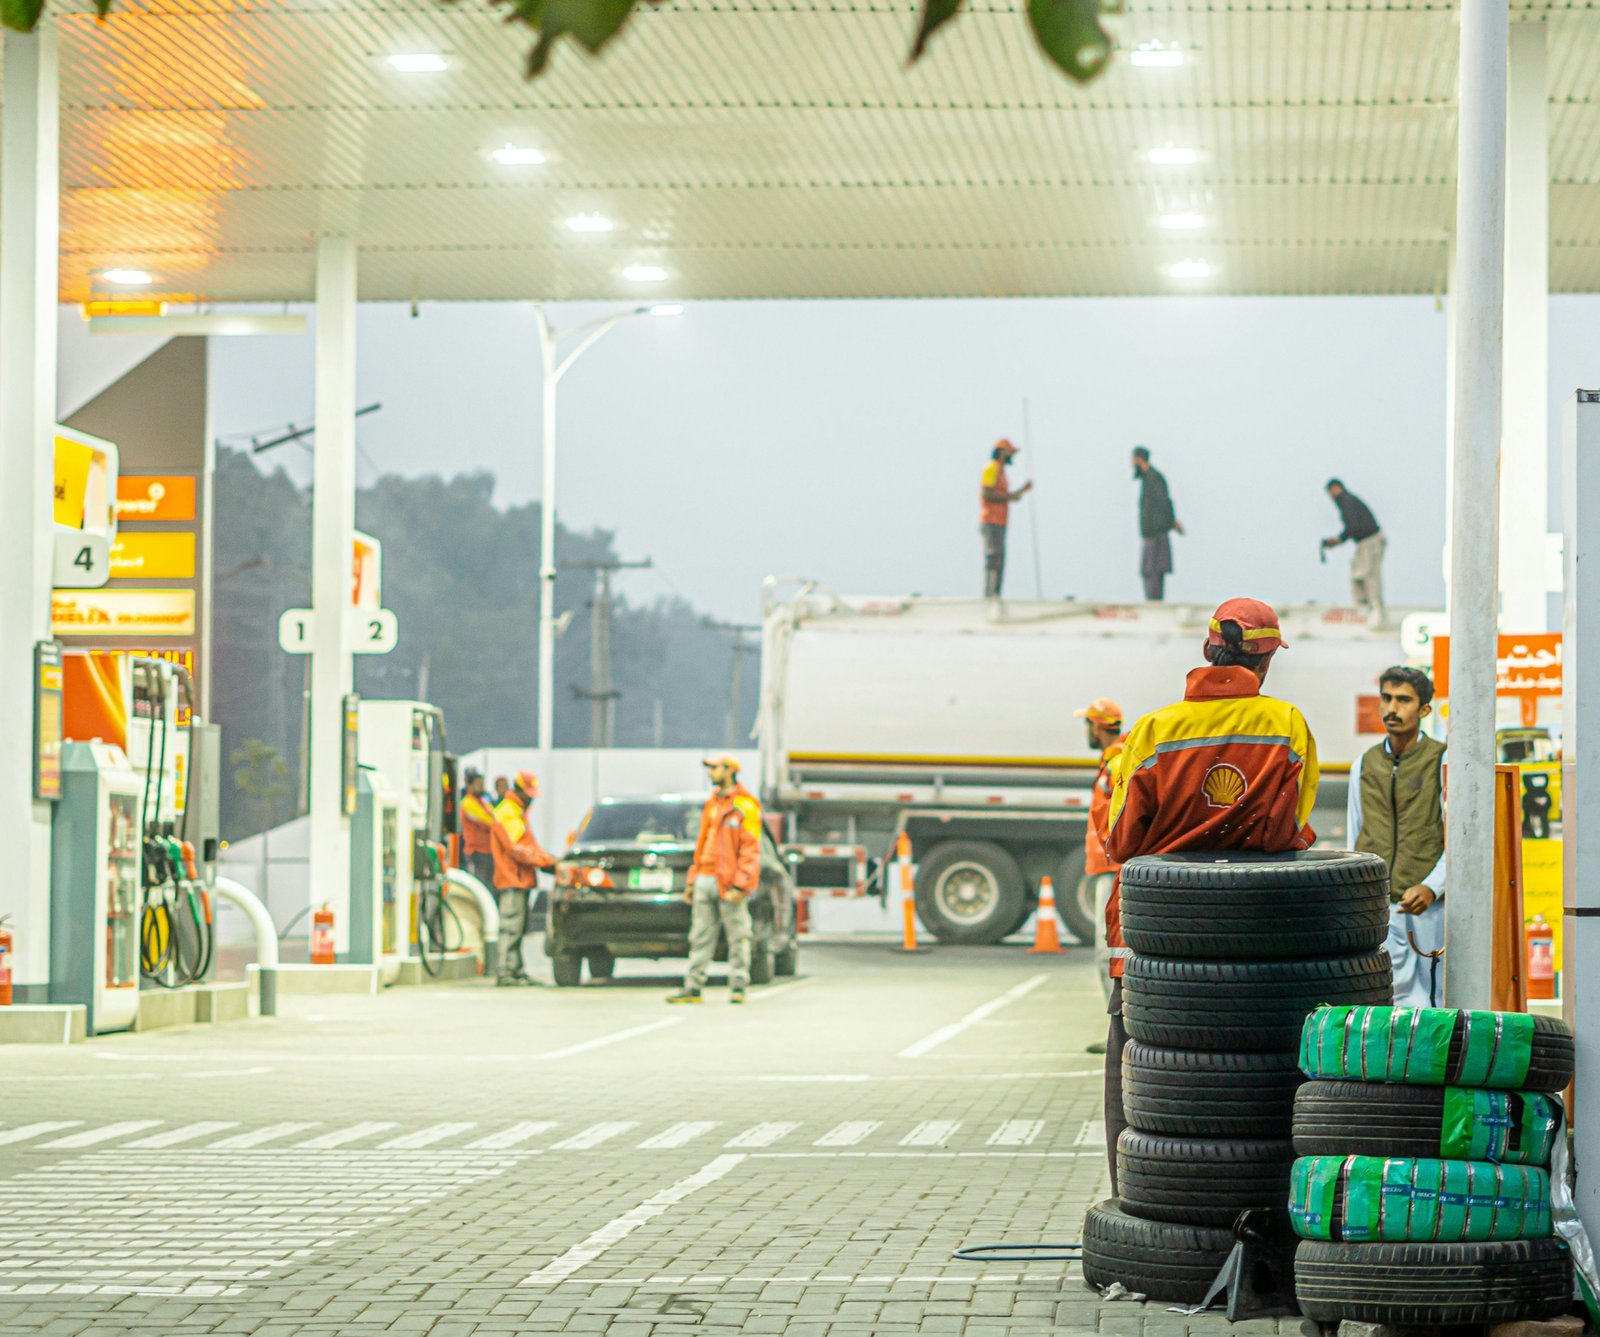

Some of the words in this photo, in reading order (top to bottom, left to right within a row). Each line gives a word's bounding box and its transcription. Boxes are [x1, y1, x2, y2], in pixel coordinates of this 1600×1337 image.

[73, 546, 95, 572] 4
[297, 622, 305, 641] 1
[369, 621, 383, 640] 2
[1416, 625, 1430, 645] 5
